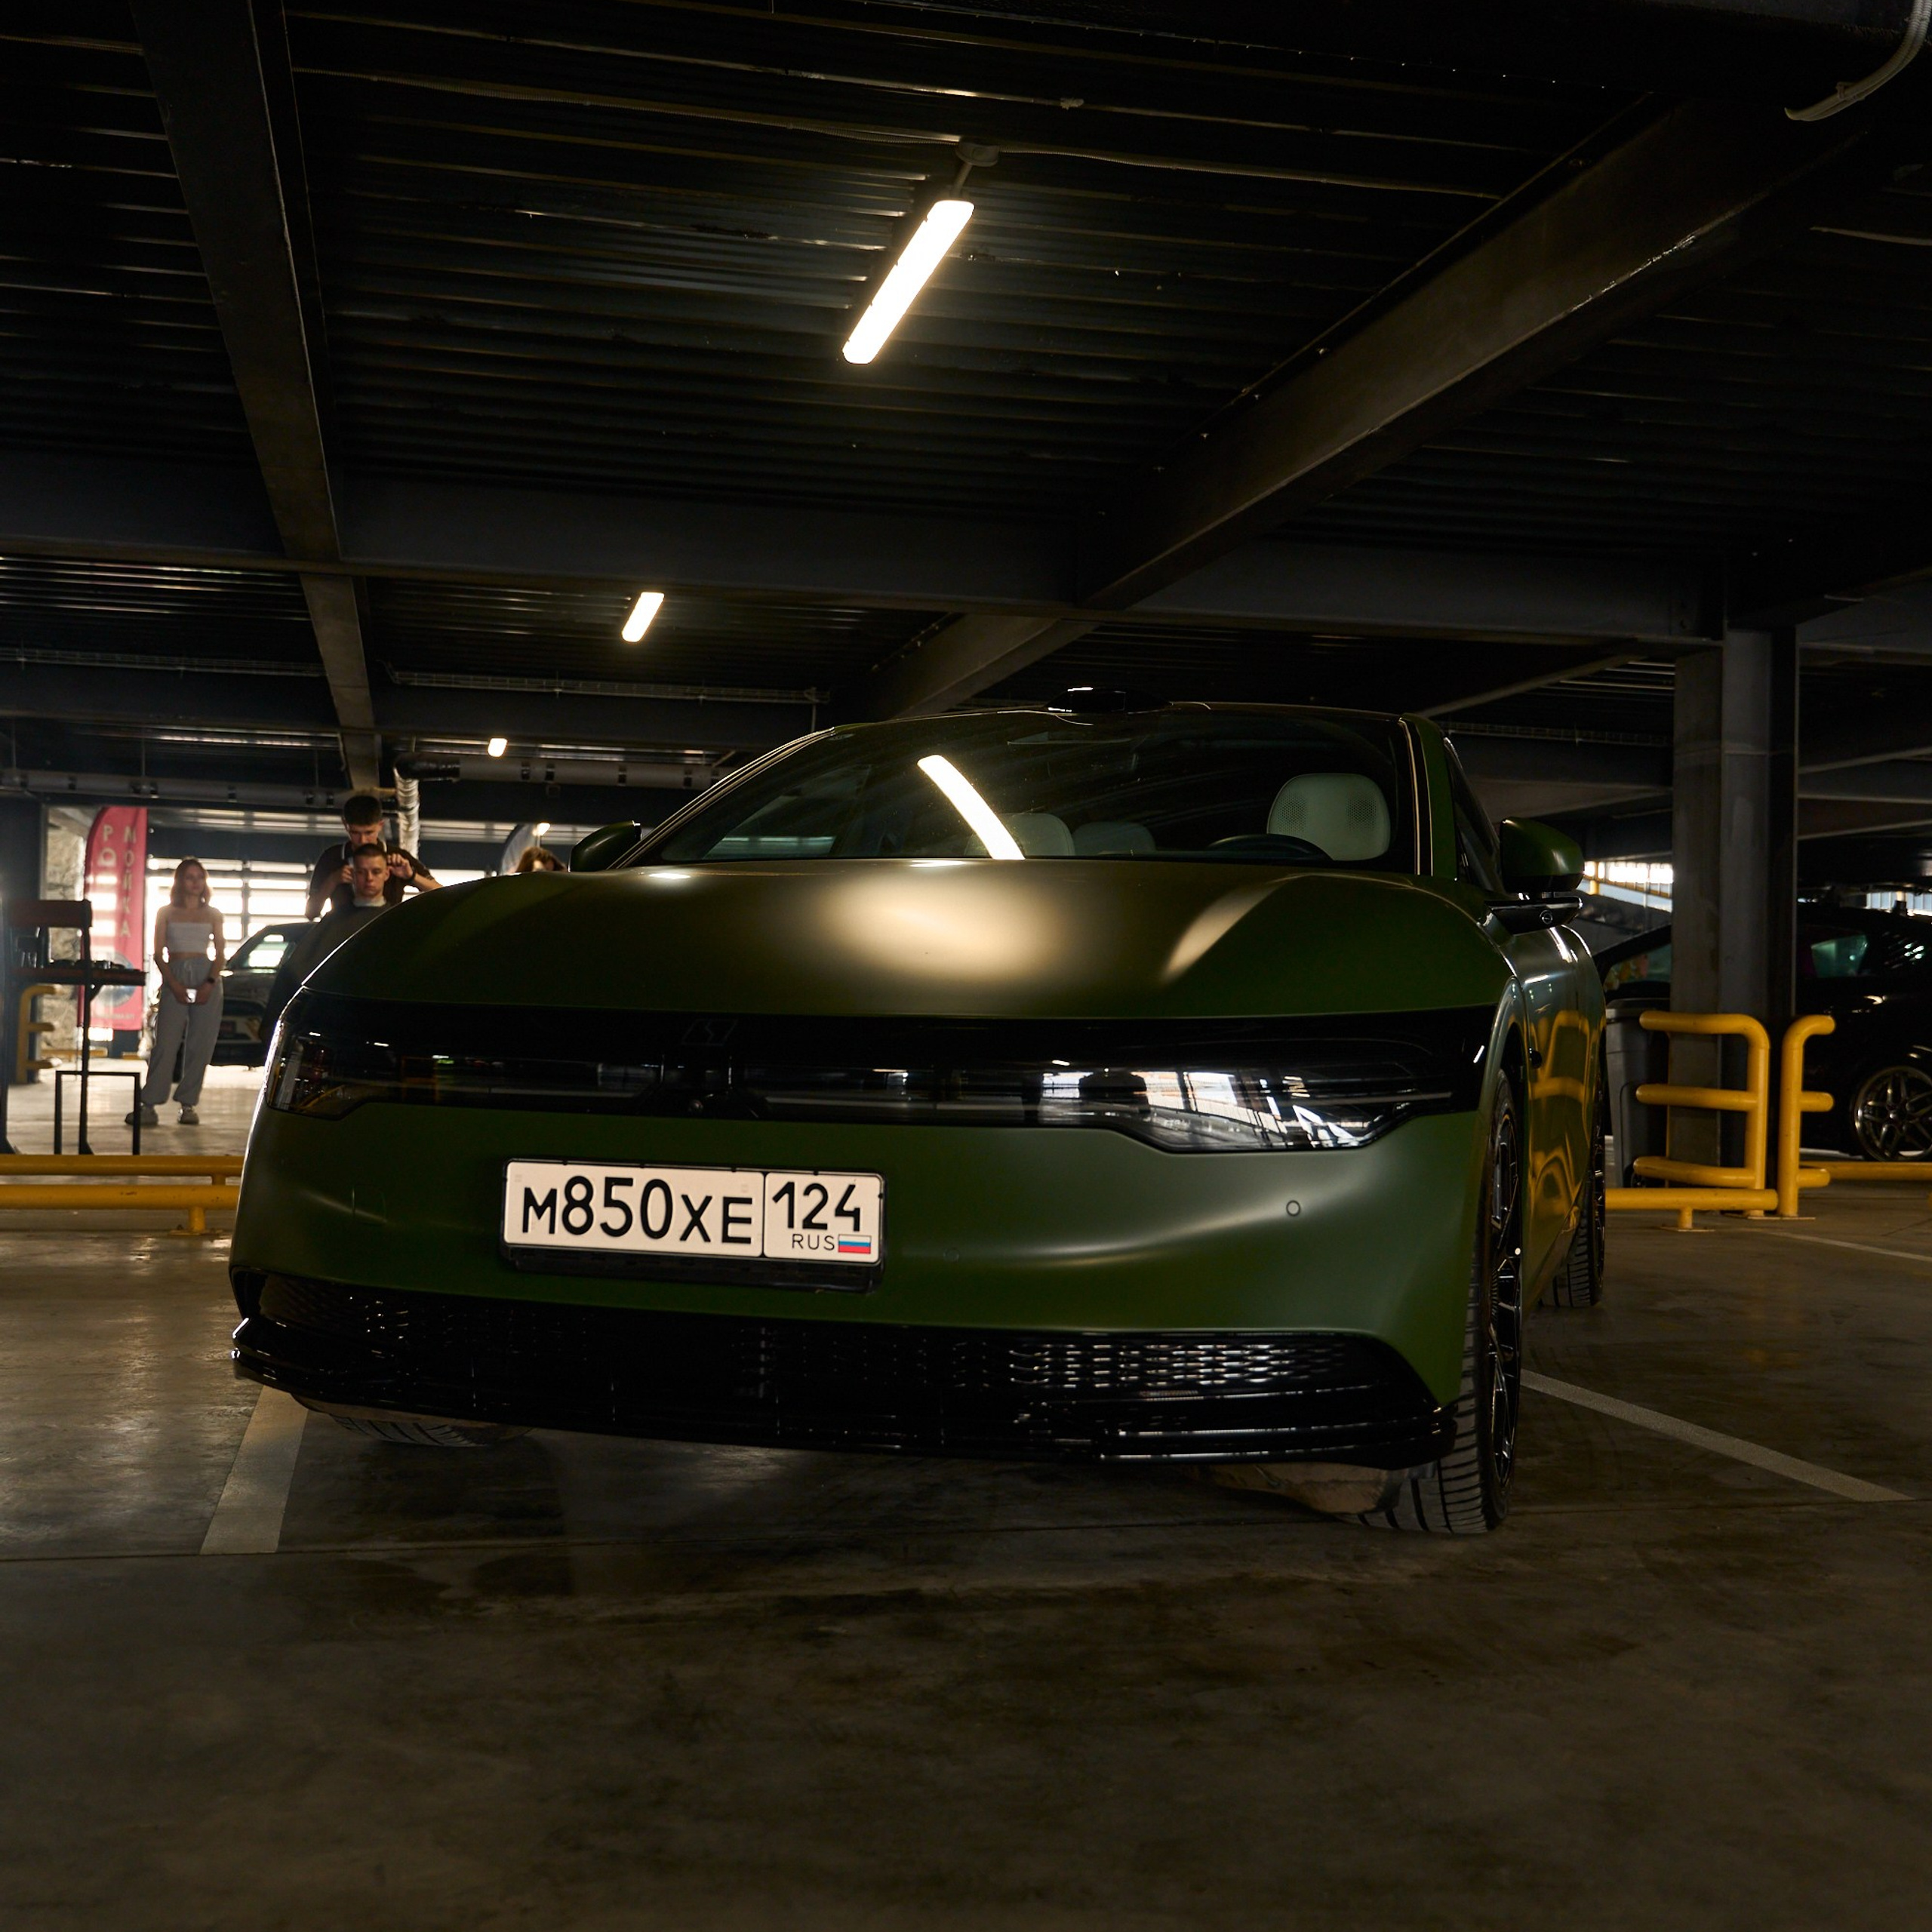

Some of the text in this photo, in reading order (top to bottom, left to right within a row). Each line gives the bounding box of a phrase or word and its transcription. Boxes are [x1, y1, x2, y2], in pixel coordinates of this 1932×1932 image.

[522, 1175, 860, 1244] М850ХЕ 124
[792, 1233, 835, 1251] RUS
